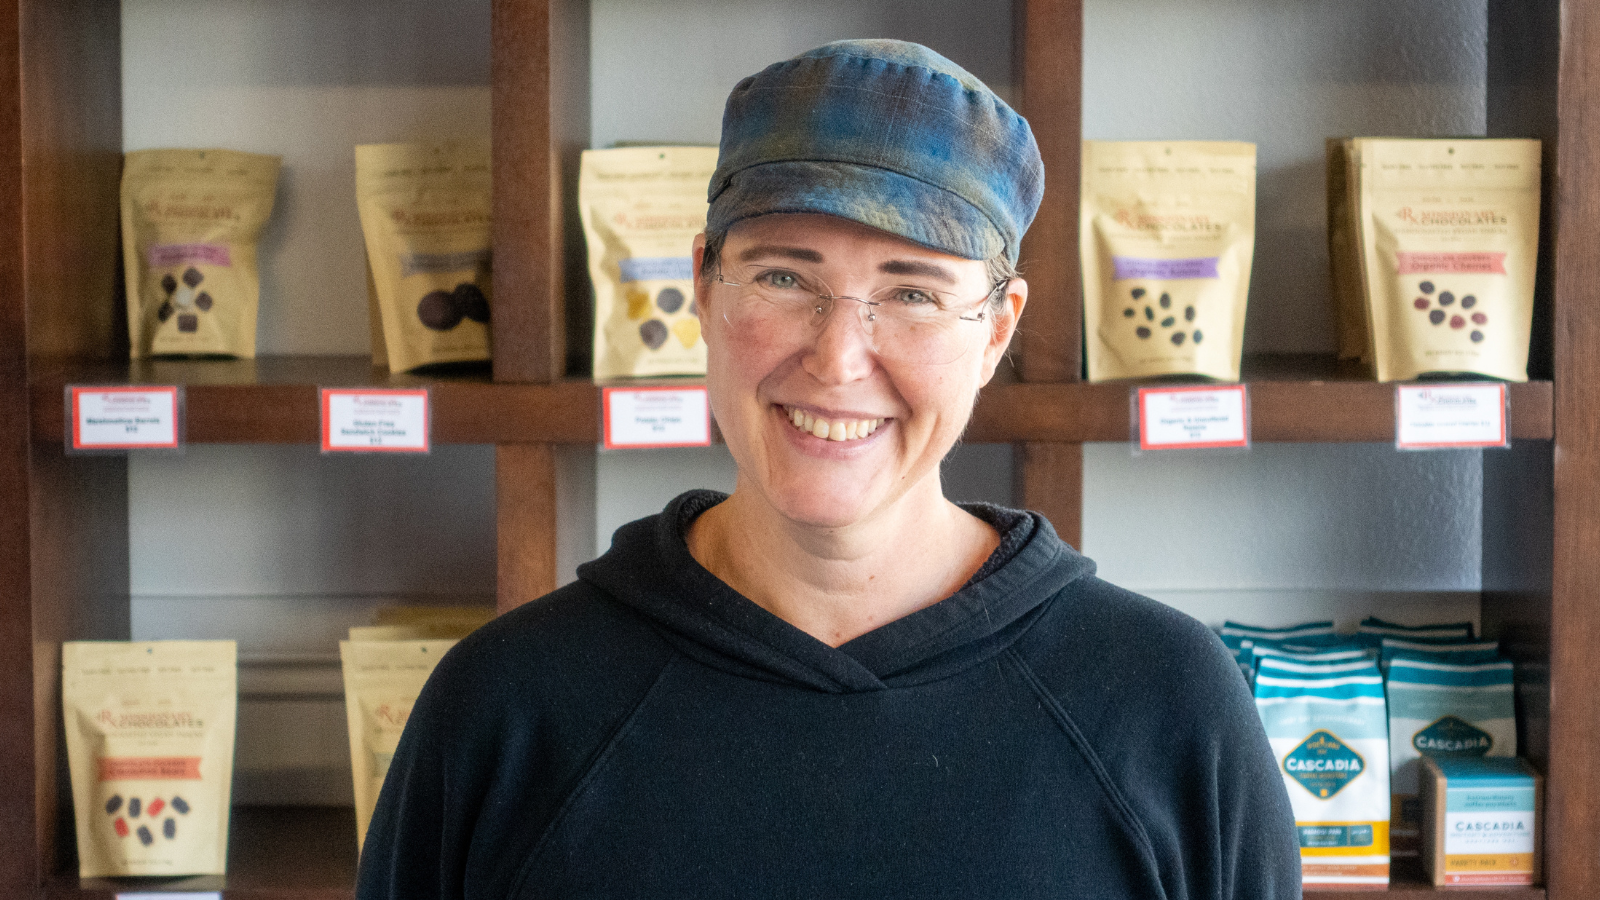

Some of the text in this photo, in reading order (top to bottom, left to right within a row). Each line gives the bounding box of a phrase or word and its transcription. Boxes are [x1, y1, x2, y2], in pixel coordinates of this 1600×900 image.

[1421, 216, 1508, 227] CHOCOLATES
[1411, 262, 1448, 273] Organic
[119, 719, 204, 730] CHOCOLATES
[1416, 735, 1489, 750] CASCADIA
[1286, 757, 1361, 771] CASCADIA
[1455, 821, 1525, 832] CASCADIA
